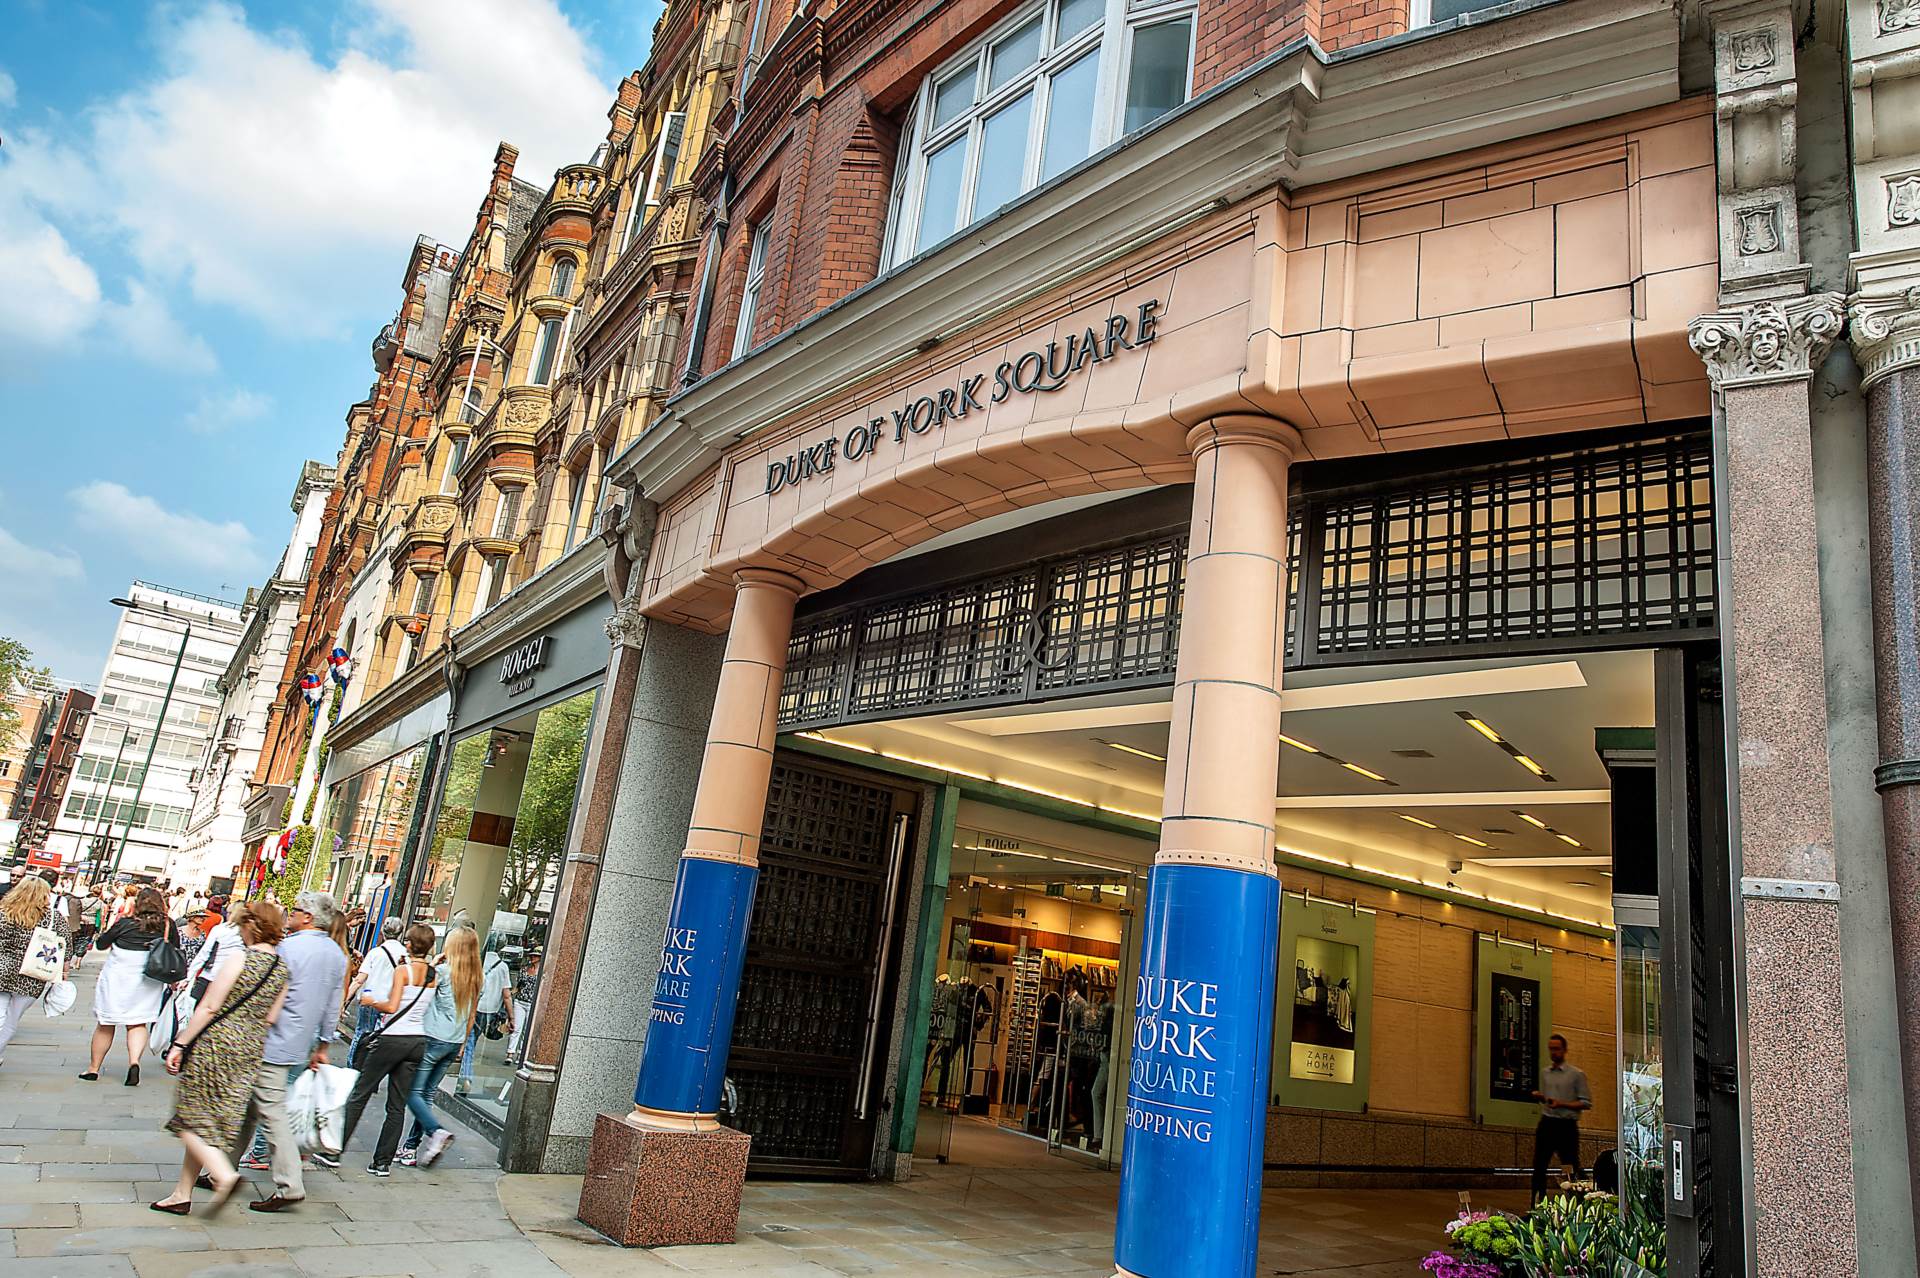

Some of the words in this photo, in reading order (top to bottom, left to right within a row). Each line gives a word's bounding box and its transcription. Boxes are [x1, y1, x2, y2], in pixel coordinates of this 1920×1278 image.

[765, 437, 838, 495] DUKE
[843, 416, 885, 460] OF
[891, 373, 986, 442] YORK
[991, 299, 1159, 402] SQUARE
[498, 634, 551, 683] BOGGI
[663, 926, 698, 951] UKE
[657, 949, 694, 977] RK
[654, 977, 691, 998] UARE
[1135, 975, 1218, 1018] DUKE
[1145, 1011, 1157, 1030] of
[1306, 1060, 1336, 1071] HOME
[1307, 1050, 1336, 1061] ZARA
